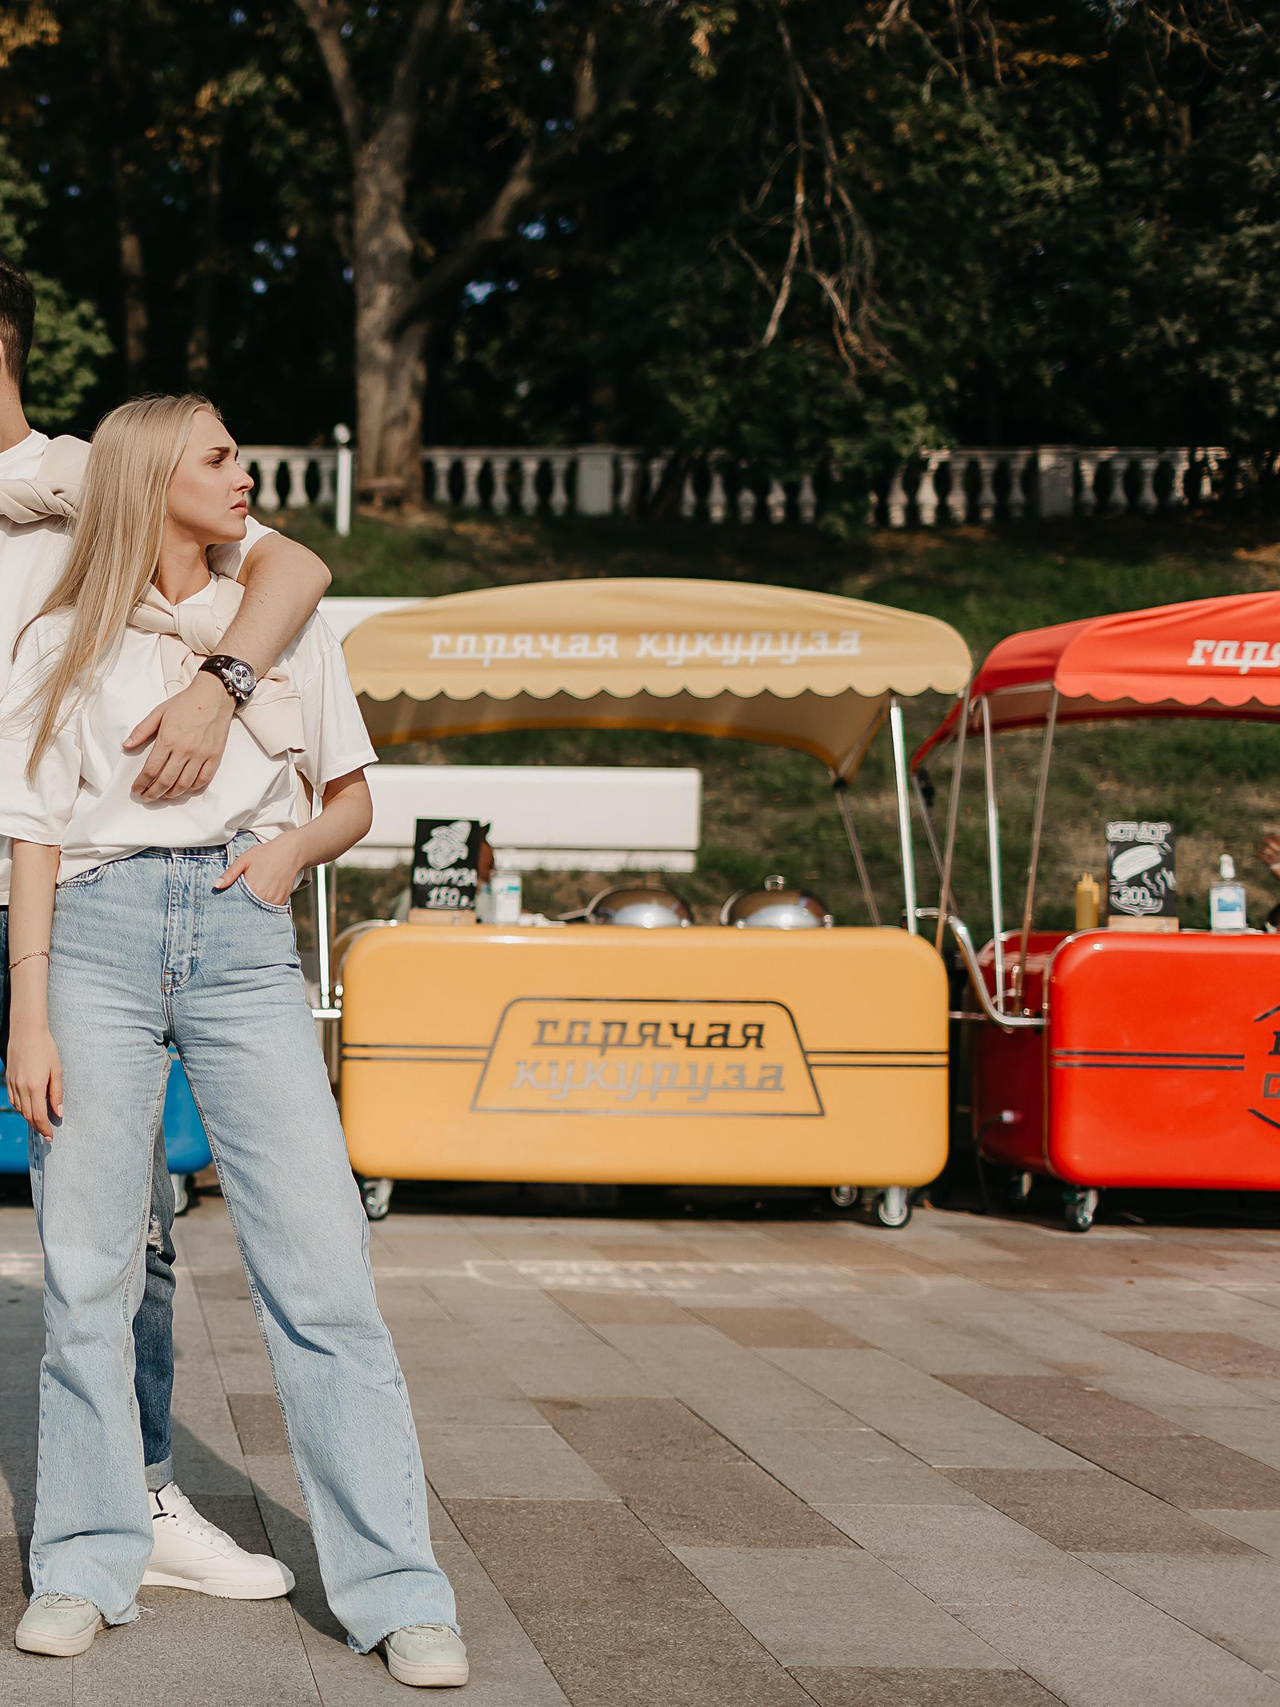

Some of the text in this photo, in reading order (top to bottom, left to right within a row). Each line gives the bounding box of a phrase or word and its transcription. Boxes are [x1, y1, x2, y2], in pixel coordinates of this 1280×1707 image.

[428, 633, 618, 668] горячая
[532, 1020, 765, 1057] горячая
[510, 1060, 785, 1101] кукуруза
